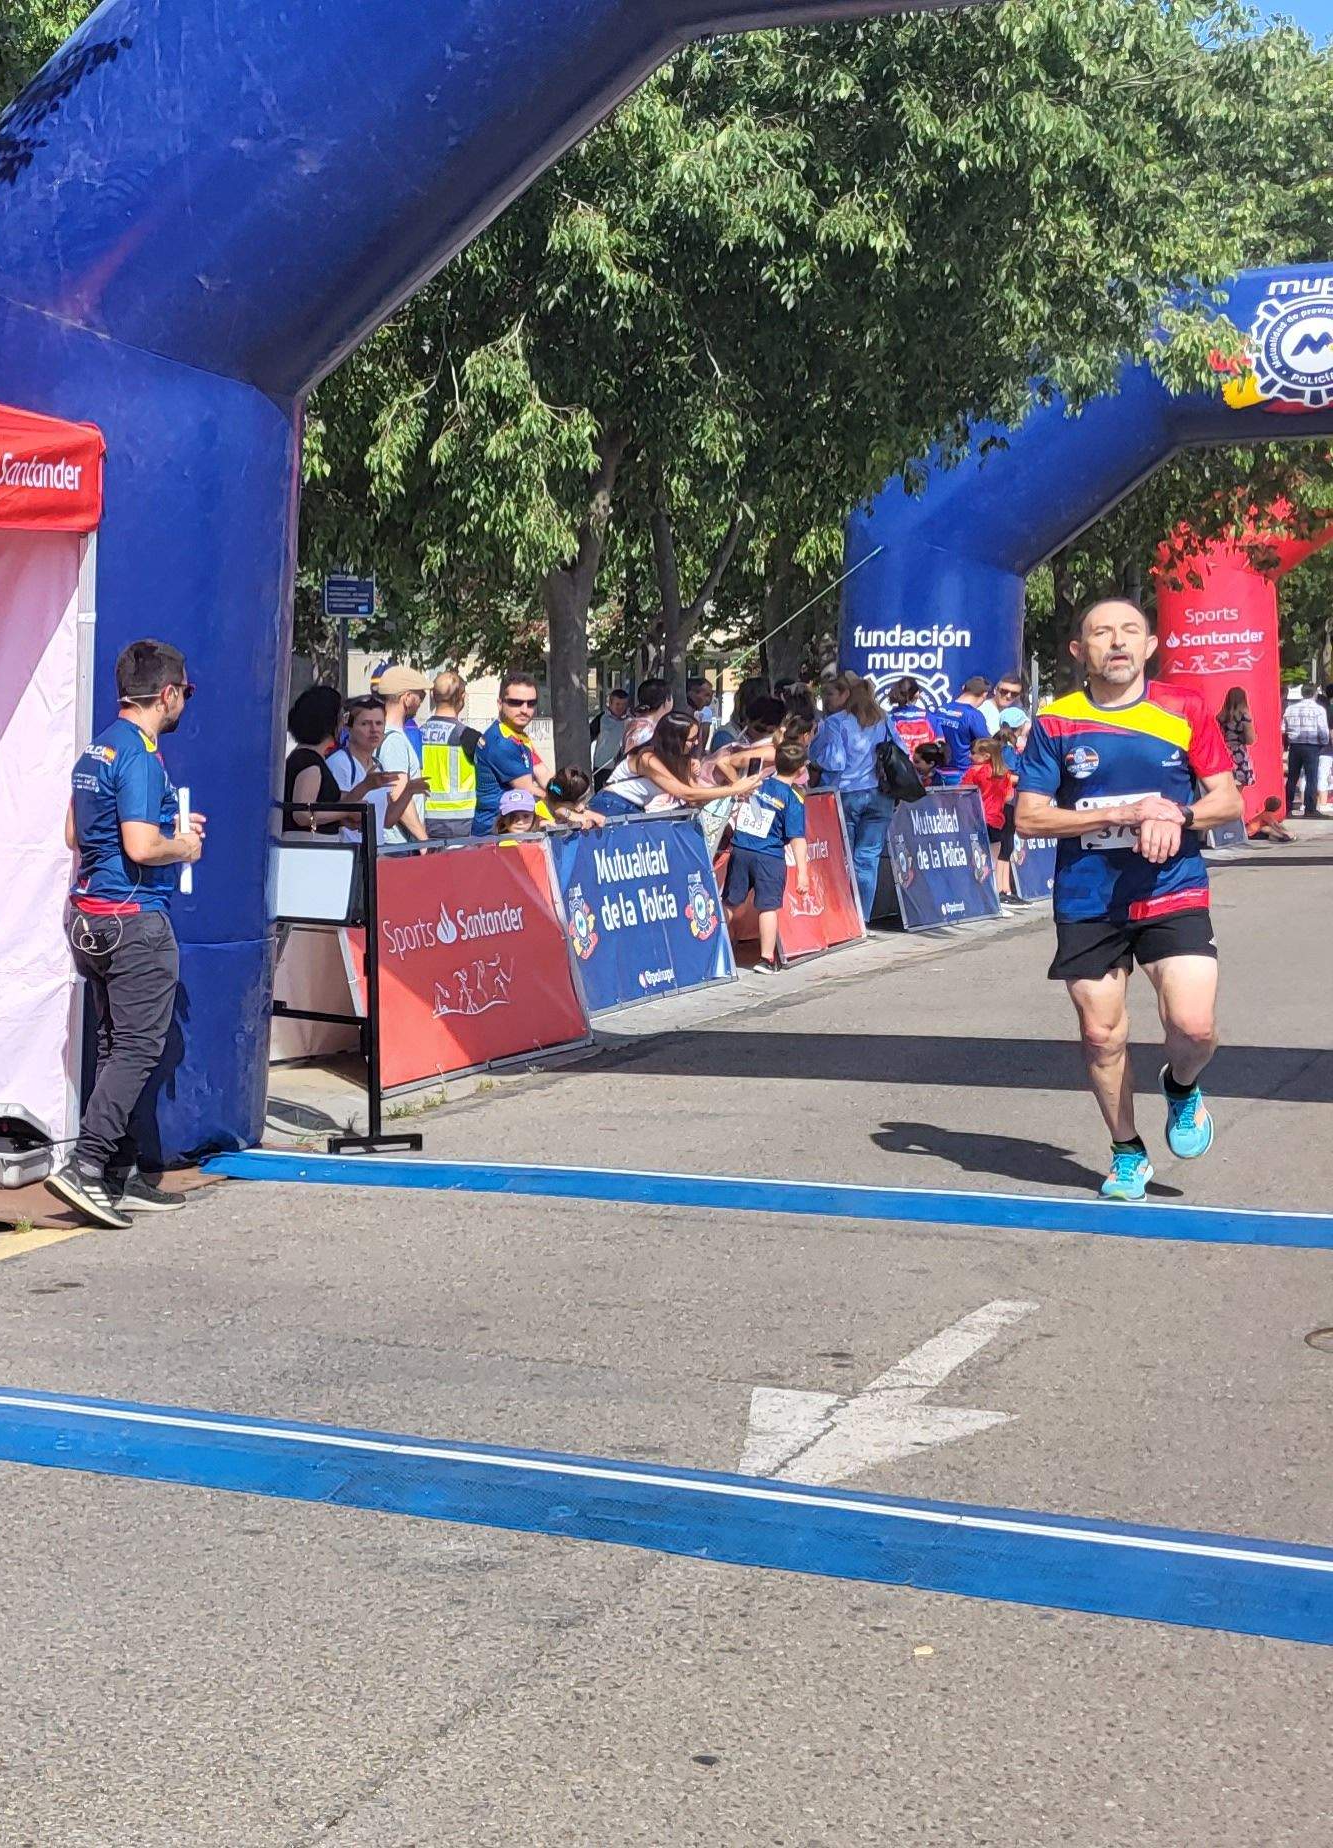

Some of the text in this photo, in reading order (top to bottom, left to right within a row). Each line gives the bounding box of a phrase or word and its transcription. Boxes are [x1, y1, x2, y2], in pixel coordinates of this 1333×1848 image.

[1268, 277, 1333, 297] mup
[1184, 607, 1239, 626] Sports
[853, 624, 972, 648] fundación
[1181, 628, 1266, 648] Santander
[867, 647, 944, 673] mupol
[593, 839, 670, 885] Mutualidad
[601, 896, 621, 931] de
[619, 892, 638, 927] la
[382, 902, 525, 961] Sports Santander
